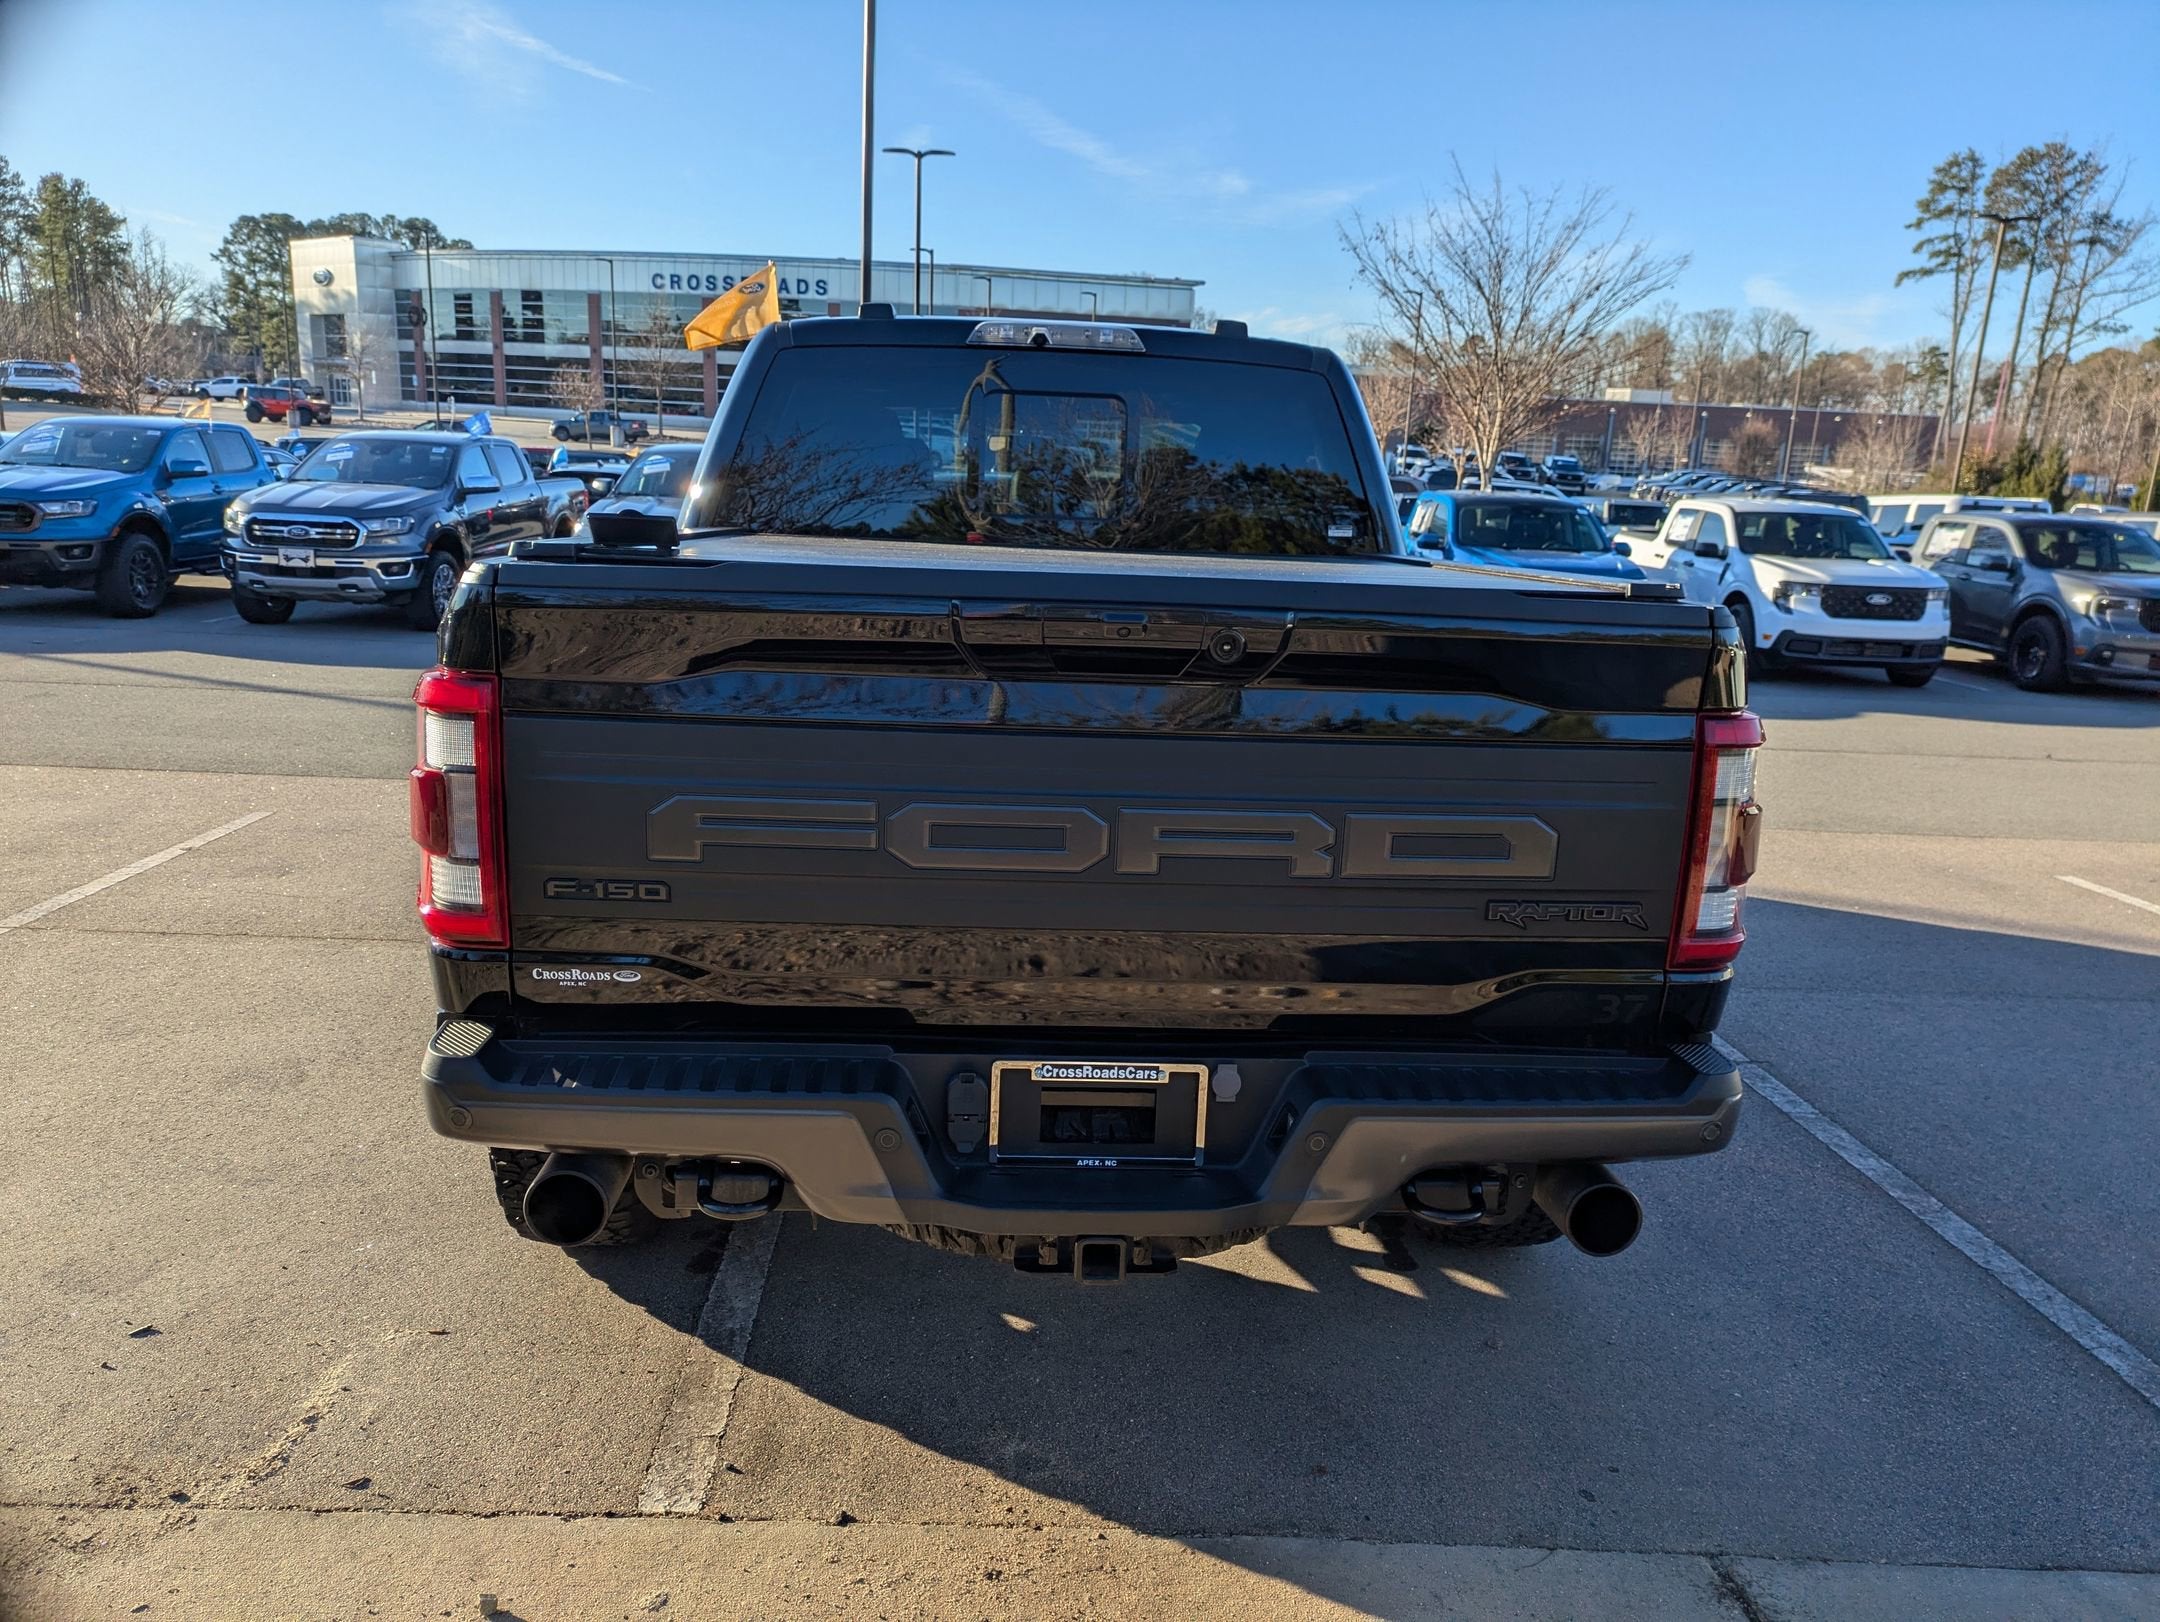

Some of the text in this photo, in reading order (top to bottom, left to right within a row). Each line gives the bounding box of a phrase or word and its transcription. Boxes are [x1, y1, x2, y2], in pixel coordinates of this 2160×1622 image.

[651, 273, 829, 297] CROSSADS
[646, 793, 1559, 881] FORD
[546, 880, 667, 900] F-150
[1486, 901, 1649, 930] RAPTOR
[1593, 994, 1649, 1024] 37
[1042, 1065, 1158, 1079] CrossRoadsCars
